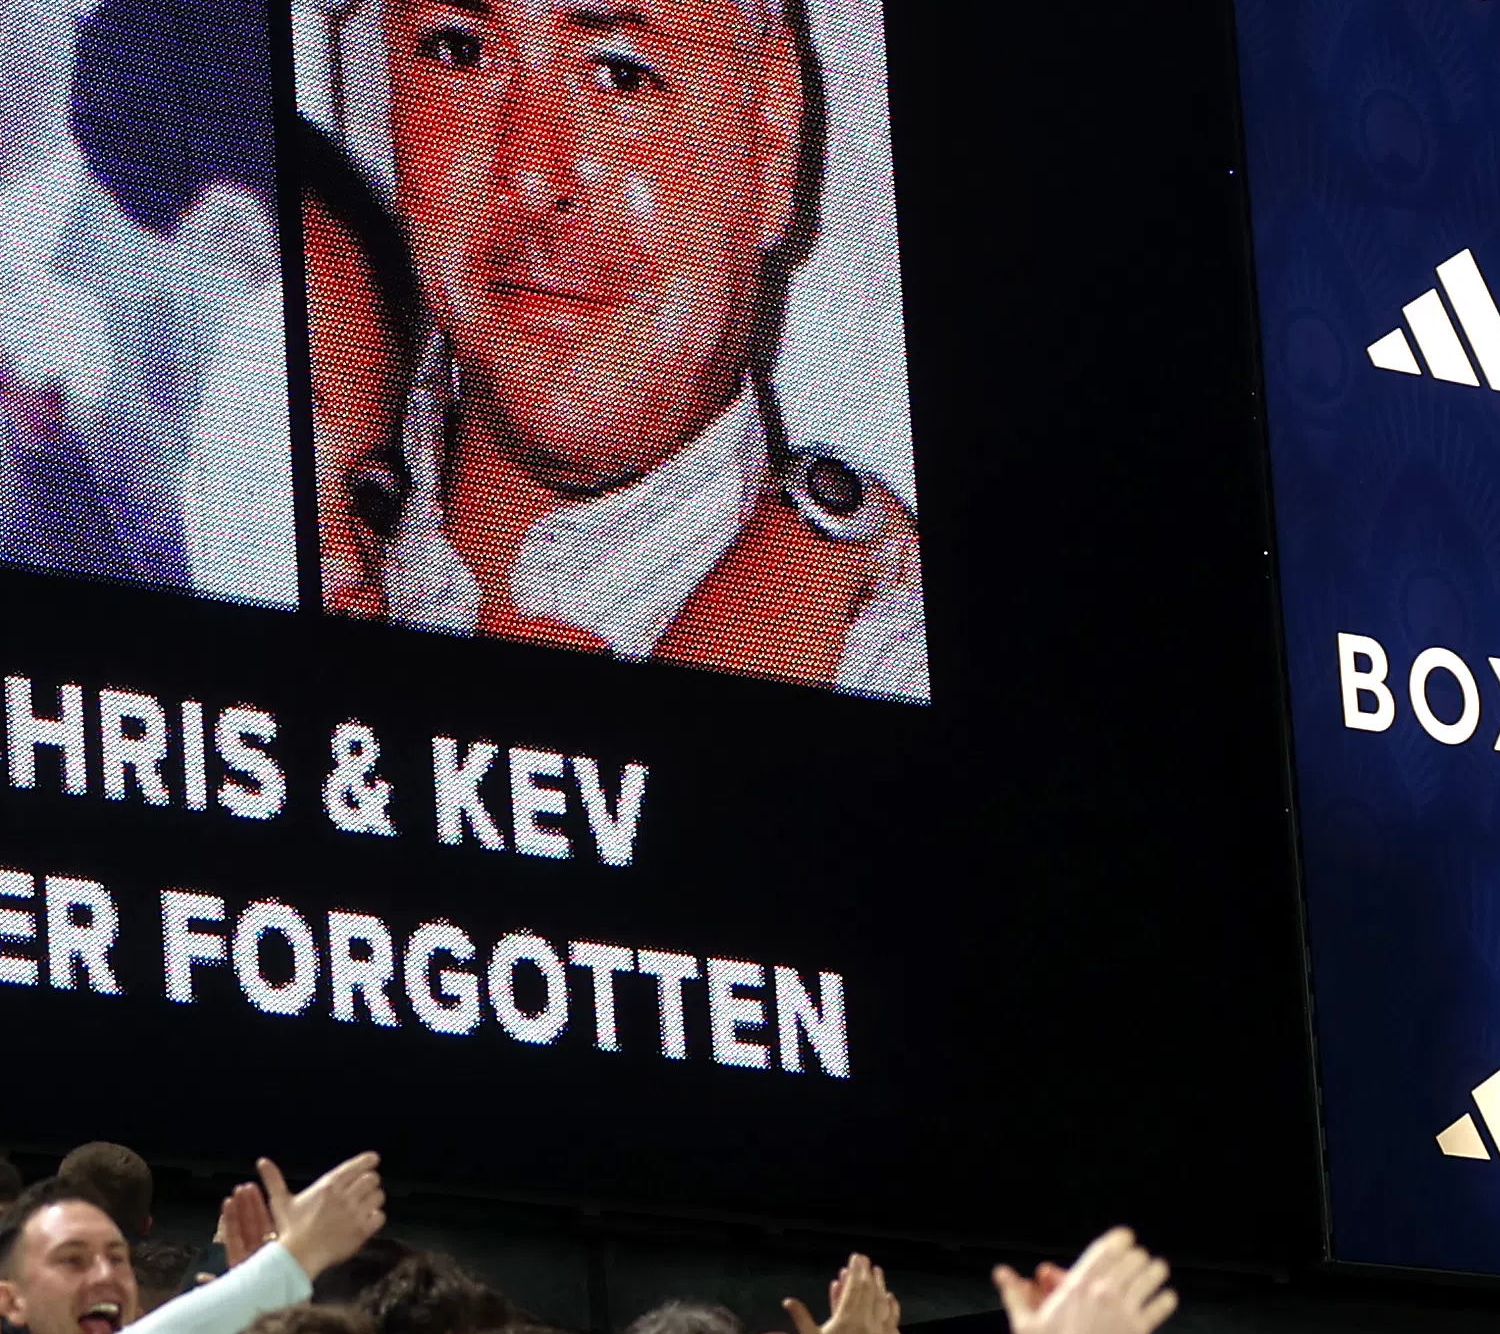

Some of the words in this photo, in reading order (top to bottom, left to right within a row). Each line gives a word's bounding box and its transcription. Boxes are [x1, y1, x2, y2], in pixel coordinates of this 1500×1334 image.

[321, 719, 396, 837] &
[432, 733, 649, 867] KEV
[160, 888, 850, 1079] FORGOTTEN
